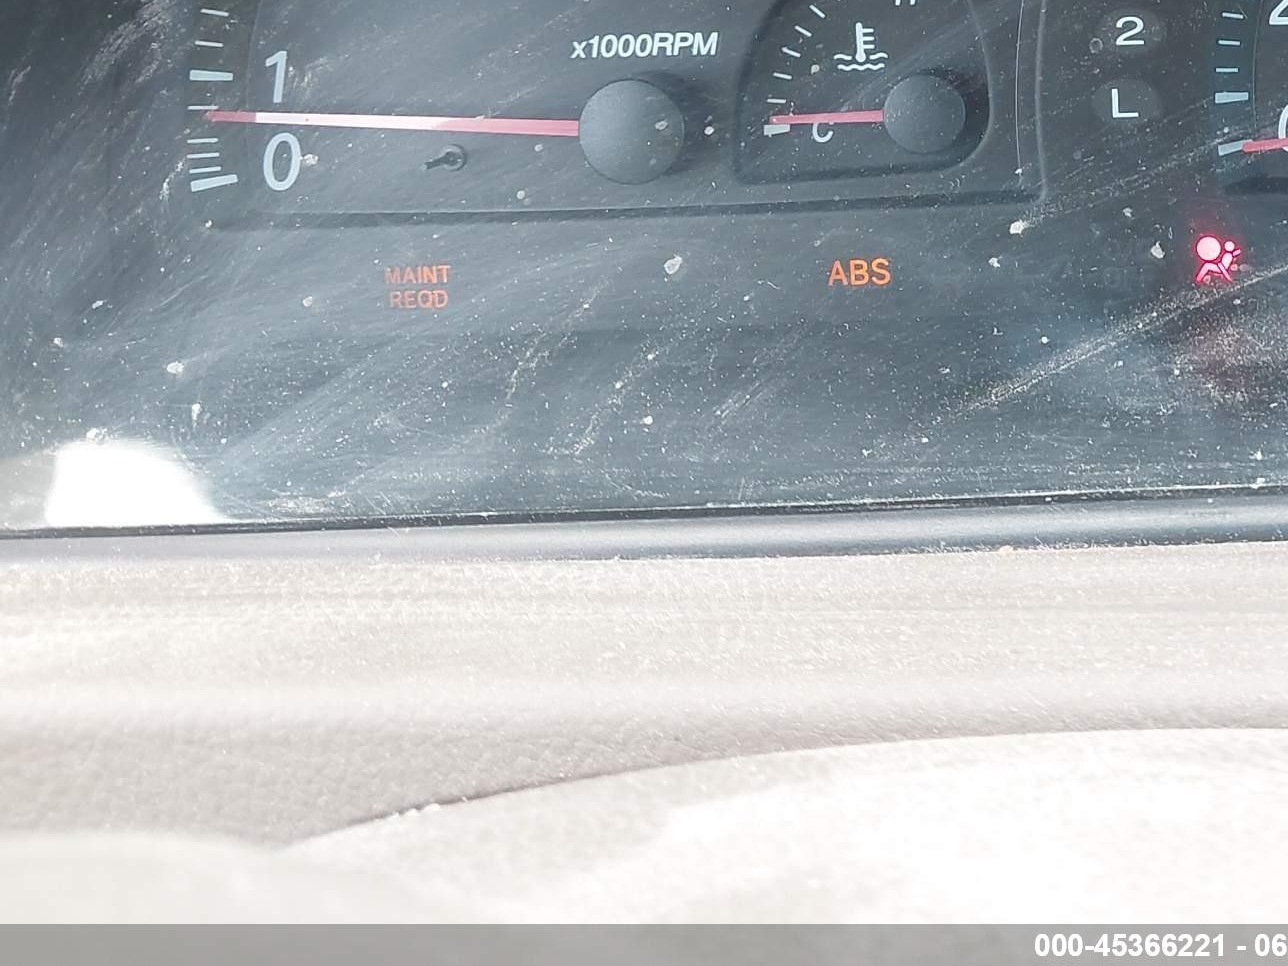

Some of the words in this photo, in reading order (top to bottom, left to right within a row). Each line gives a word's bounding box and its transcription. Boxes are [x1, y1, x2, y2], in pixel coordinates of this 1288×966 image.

[570, 32, 719, 60] x1000RPM
[1115, 17, 1145, 46] 2
[264, 50, 288, 104] 1
[1111, 89, 1139, 118] L
[263, 132, 301, 192] 0
[384, 264, 451, 284] MAINT
[828, 258, 892, 286] ABS
